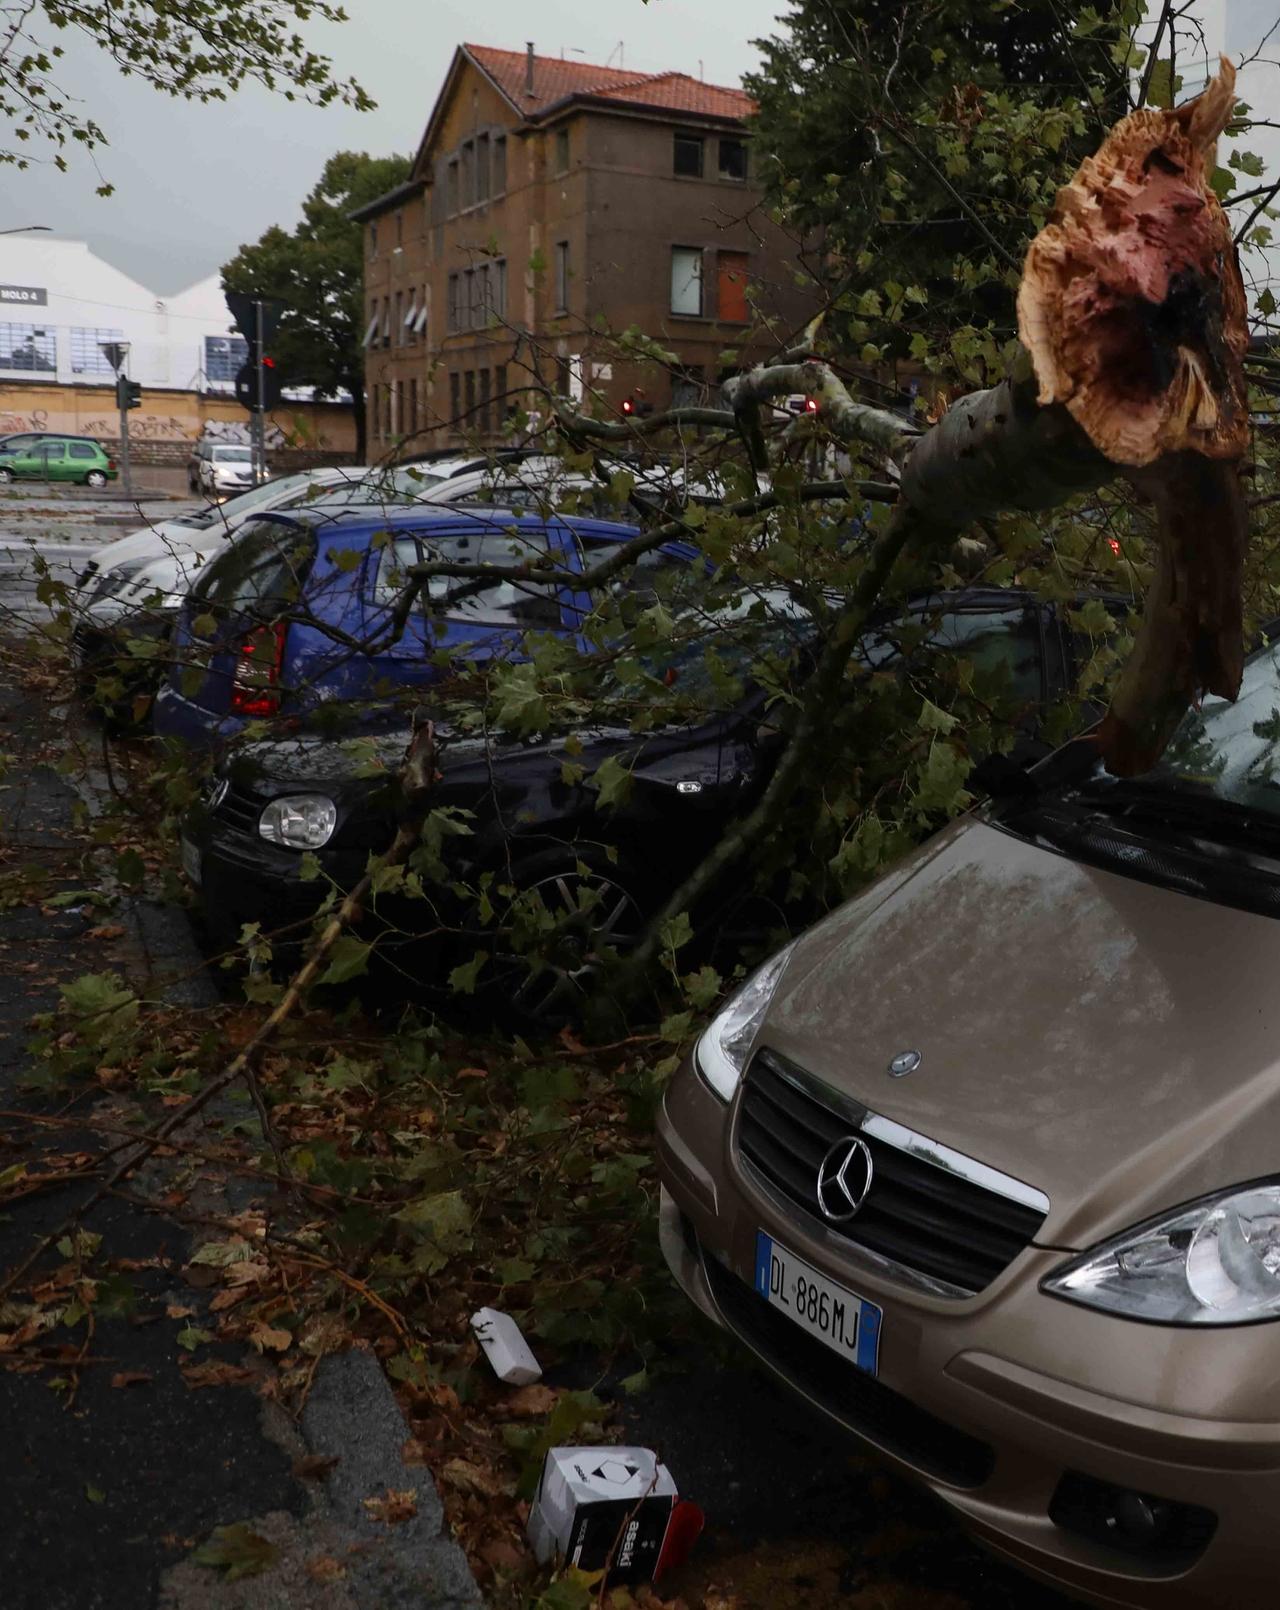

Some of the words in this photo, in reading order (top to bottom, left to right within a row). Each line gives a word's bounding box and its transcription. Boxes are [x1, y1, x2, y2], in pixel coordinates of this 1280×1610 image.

[1, 289, 29, 300] MOLO
[30, 291, 38, 301] 4
[620, 1521, 639, 1567] asaki
